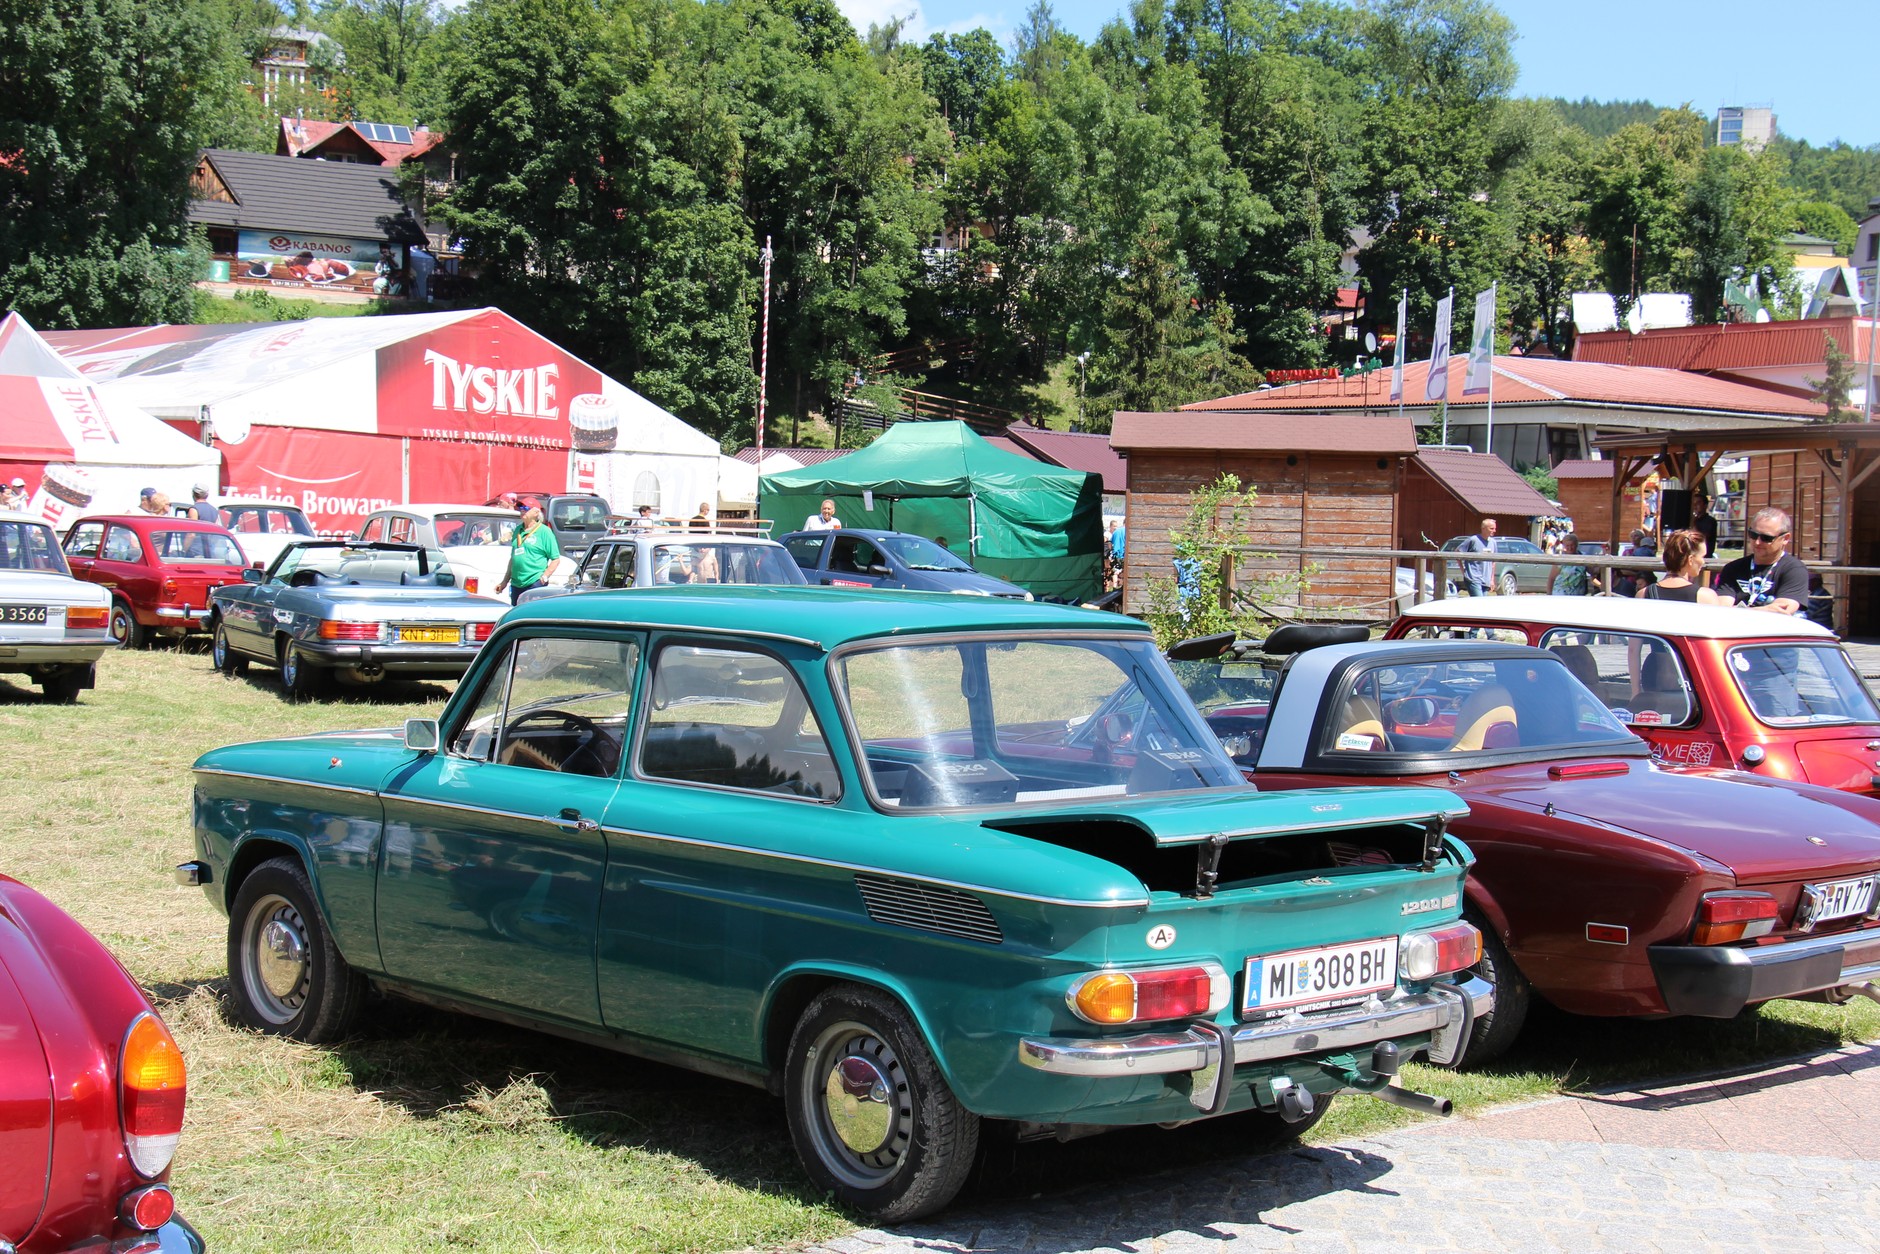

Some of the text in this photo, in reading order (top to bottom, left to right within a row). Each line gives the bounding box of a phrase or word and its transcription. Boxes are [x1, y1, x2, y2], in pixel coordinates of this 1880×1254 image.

[293, 240, 352, 254] KABANOS
[424, 348, 560, 420] TYSKIE
[57, 386, 106, 442] TYSKIE
[422, 428, 459, 439] TYSKIE
[464, 431, 512, 443] BROWARY
[9, 607, 46, 621] 3566
[401, 629, 444, 641] KNT 3H
[1852, 880, 1872, 911] 77
[1400, 897, 1441, 916] 1200
[1155, 928, 1167, 944] A
[1270, 947, 1386, 998] MI 308 BH
[1250, 993, 1258, 1001] A
